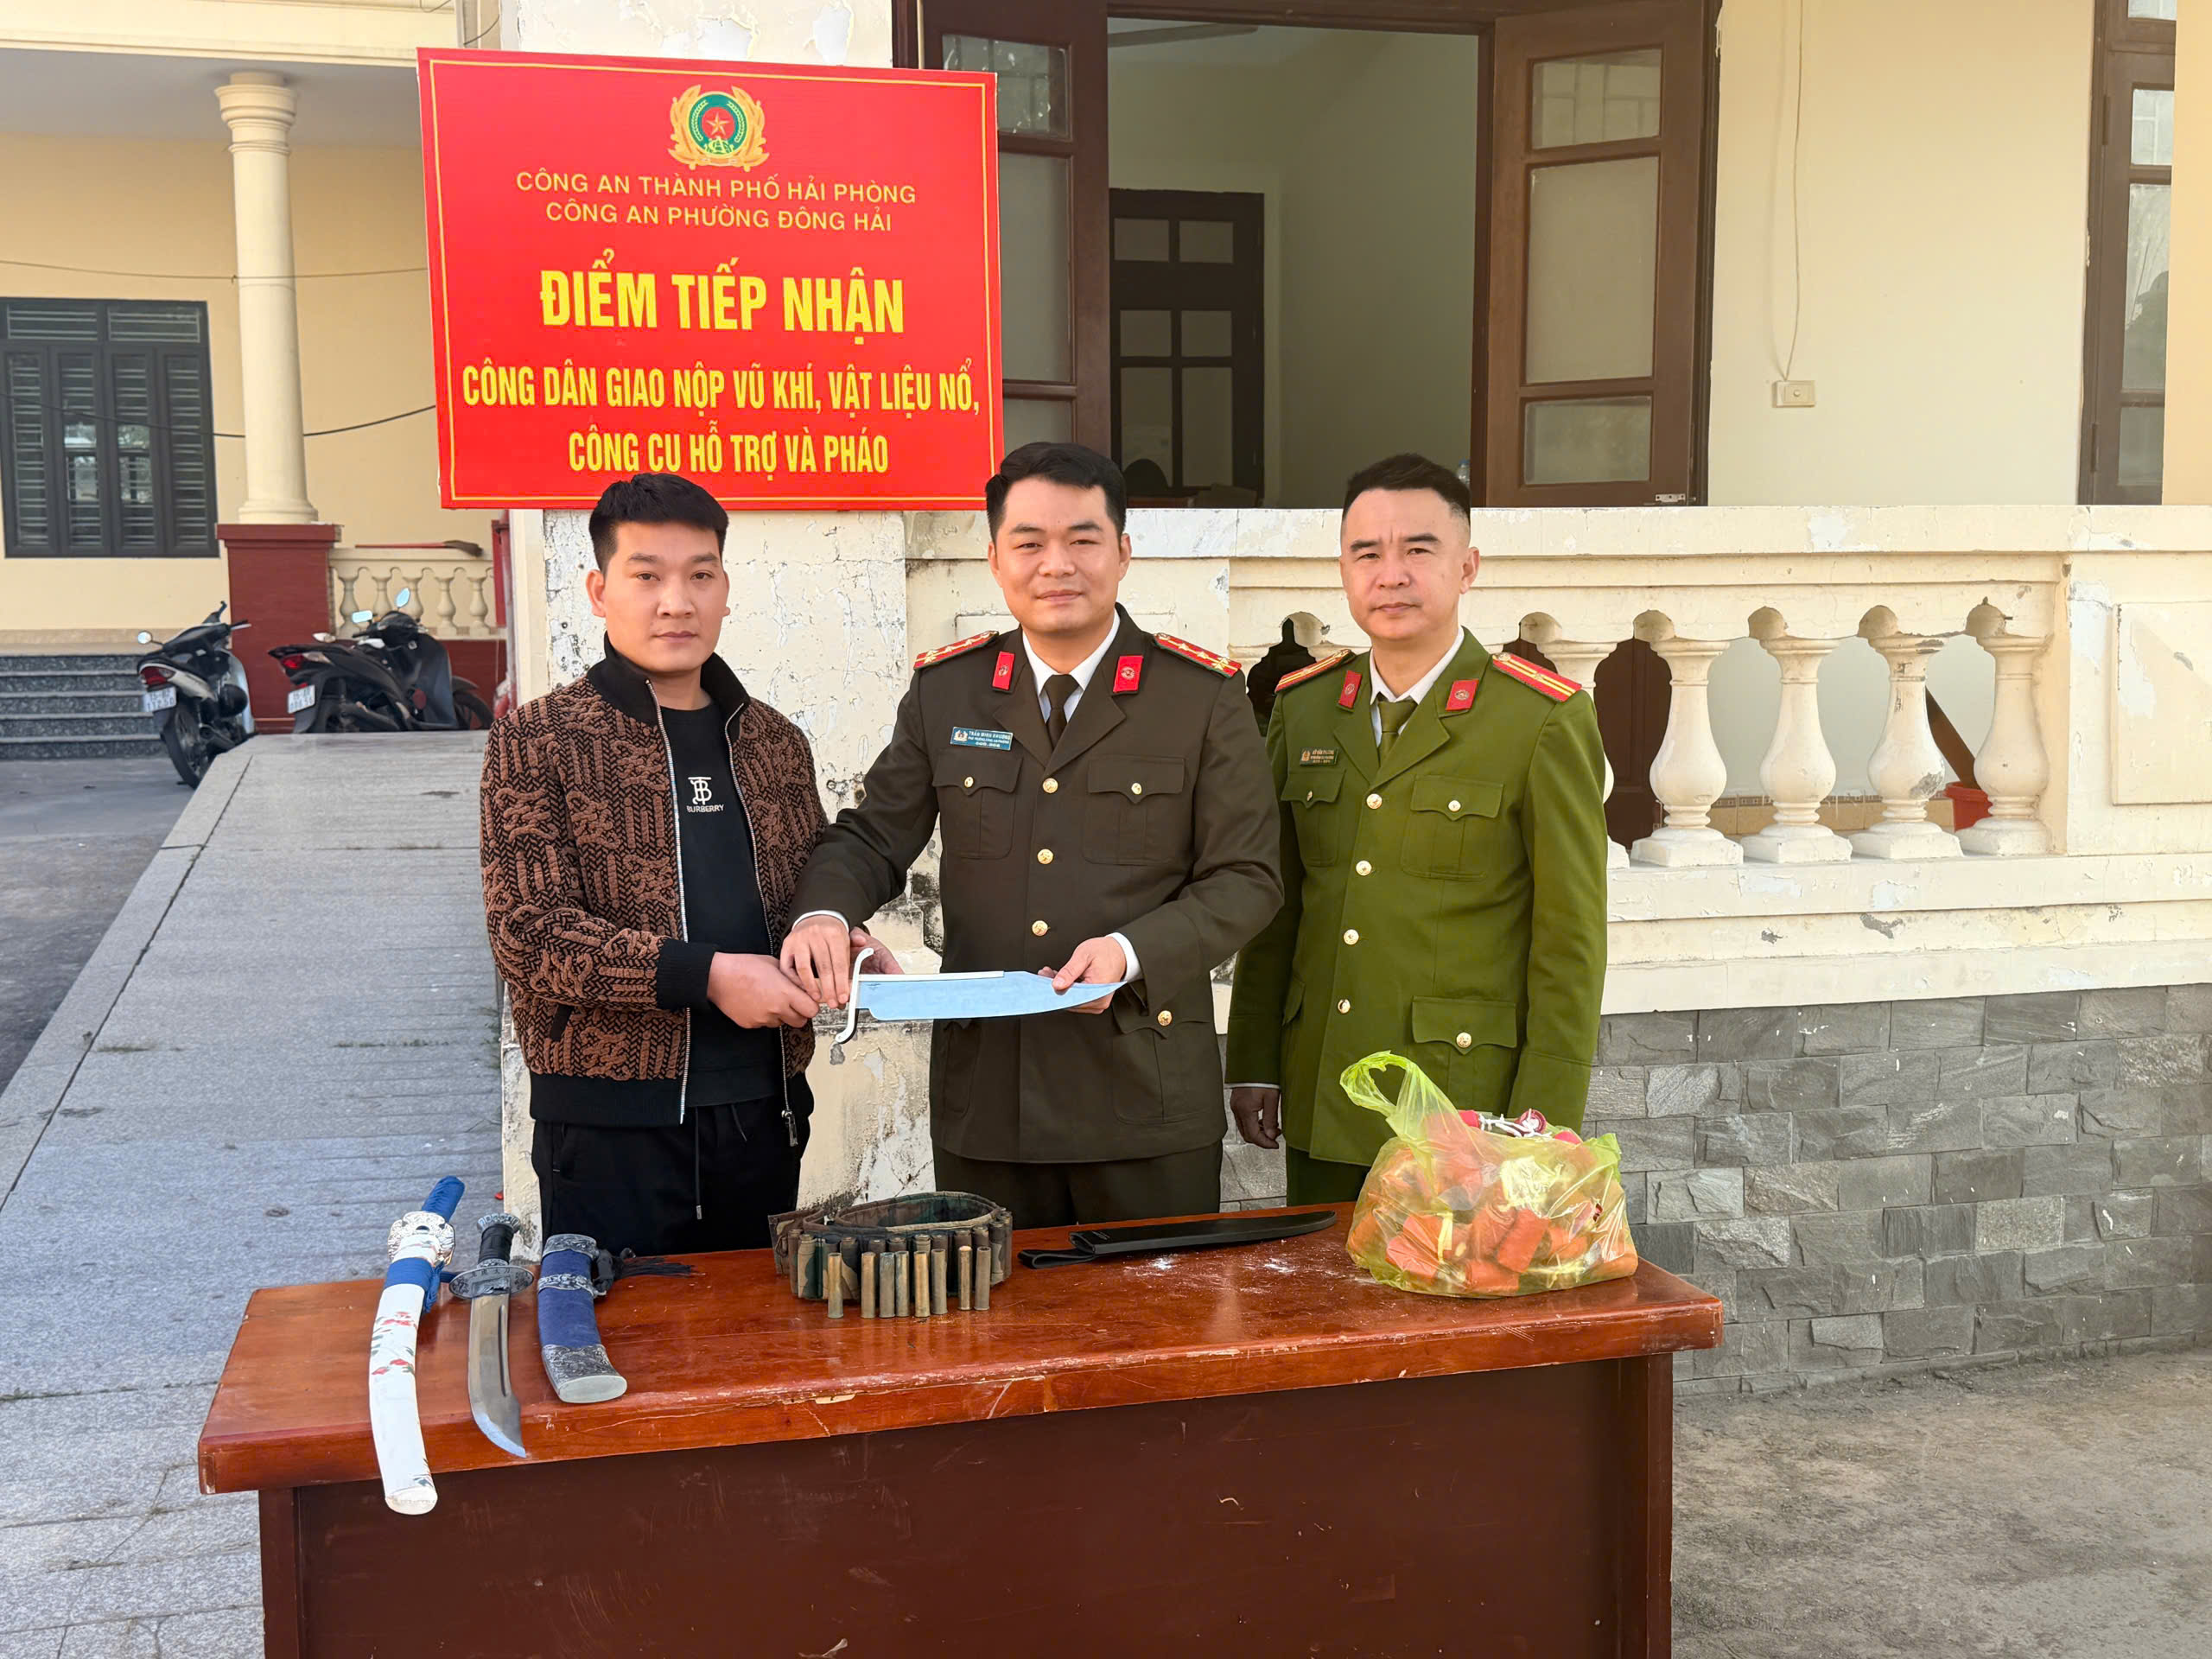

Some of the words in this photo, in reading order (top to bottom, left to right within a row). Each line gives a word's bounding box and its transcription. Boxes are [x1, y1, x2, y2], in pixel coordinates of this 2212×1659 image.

[516, 168, 588, 193] CÔNG
[597, 174, 630, 194] AN
[638, 172, 721, 198] THÀNH
[730, 173, 780, 200] PHỐ
[787, 175, 826, 201] HẢI
[833, 179, 916, 204] PHÒNG
[545, 199, 618, 223] CÔNG
[626, 205, 659, 225] AN
[668, 203, 770, 229] PHƯỜNG
[777, 205, 845, 231] ĐÔNG
[854, 207, 892, 232] HẢI
[539, 248, 658, 328] ĐIỂM
[671, 257, 767, 331] TIẾP
[782, 266, 905, 346] NHẬN
[462, 357, 536, 406] CÔNG
[543, 358, 598, 406] DÂN
[606, 367, 665, 409] GIAO
[673, 360, 725, 414] NỘP
[732, 364, 765, 410] VŨ
[772, 362, 822, 415] KHÍ,
[828, 363, 873, 416] VẬT
[880, 364, 931, 417] LIỆU
[938, 357, 980, 416] NỔ,
[569, 423, 640, 473] CÔNG
[689, 419, 723, 474] HỖ
[729, 430, 778, 481] TRỢ
[784, 426, 817, 473] VÀ
[823, 426, 889, 474] PHÁO
[686, 804, 724, 813] BURBERRY
